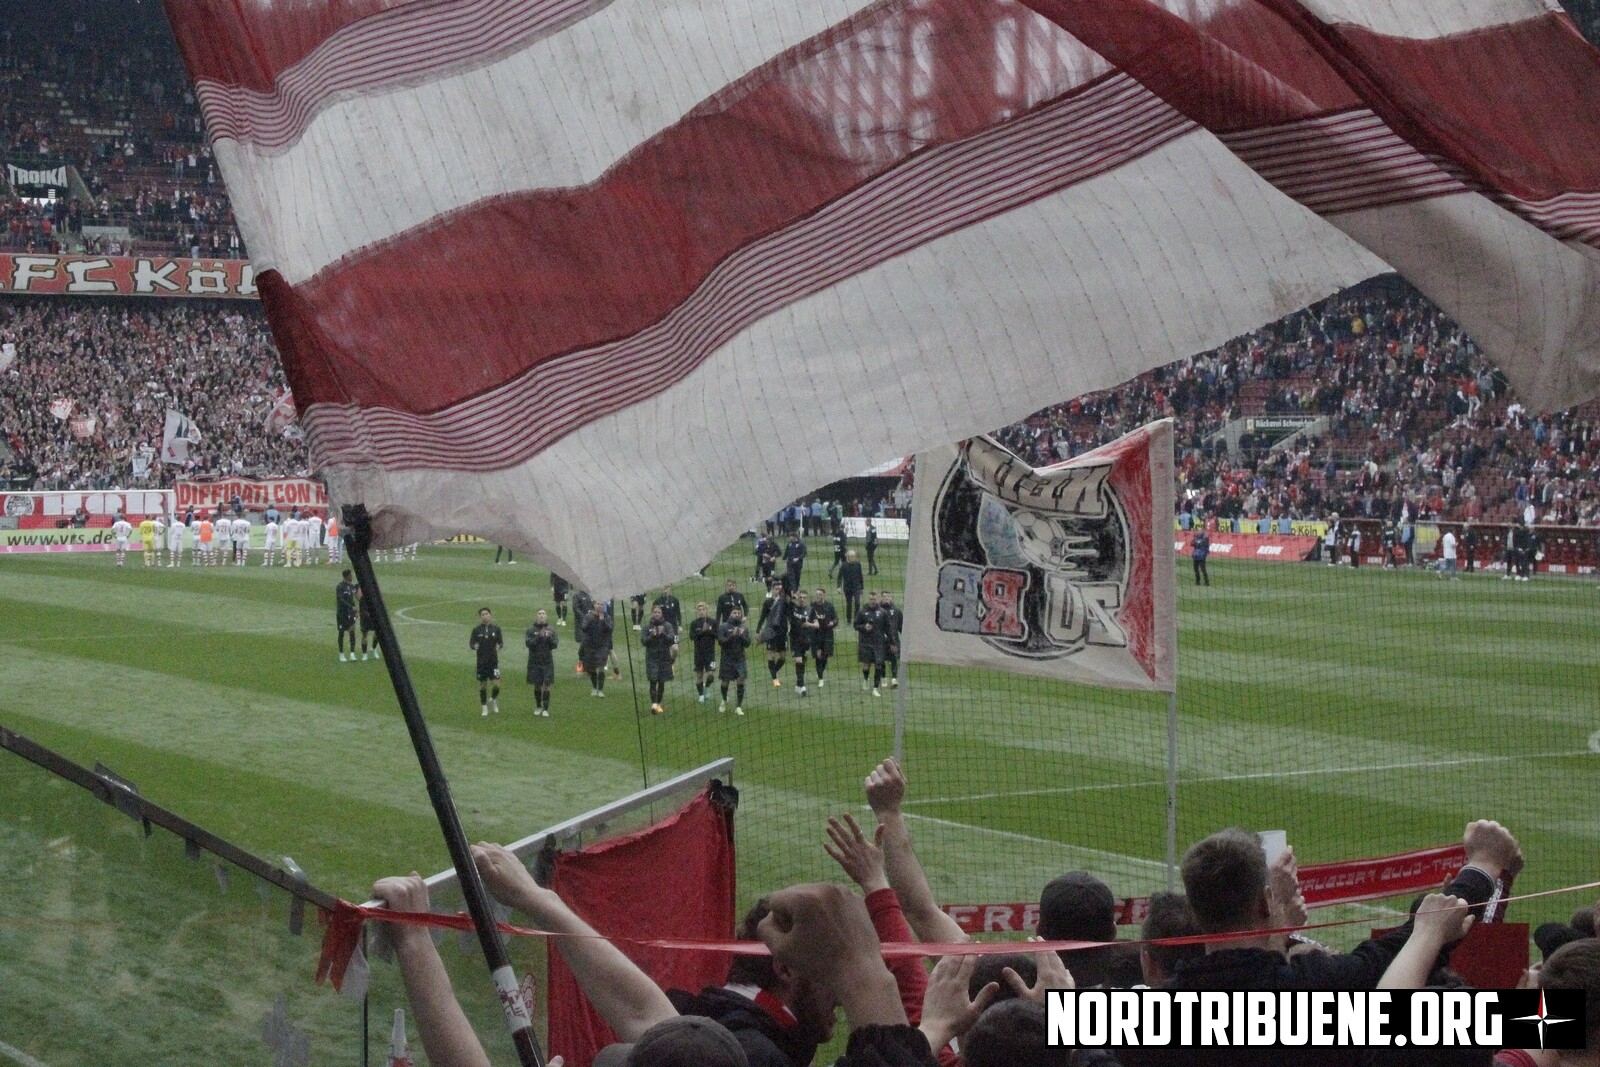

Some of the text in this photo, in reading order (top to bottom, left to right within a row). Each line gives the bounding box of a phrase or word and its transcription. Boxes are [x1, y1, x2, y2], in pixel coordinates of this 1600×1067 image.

[7, 163, 68, 188] TROIKA
[178, 481, 269, 505] DIFFIDATI
[273, 482, 311, 504] CON
